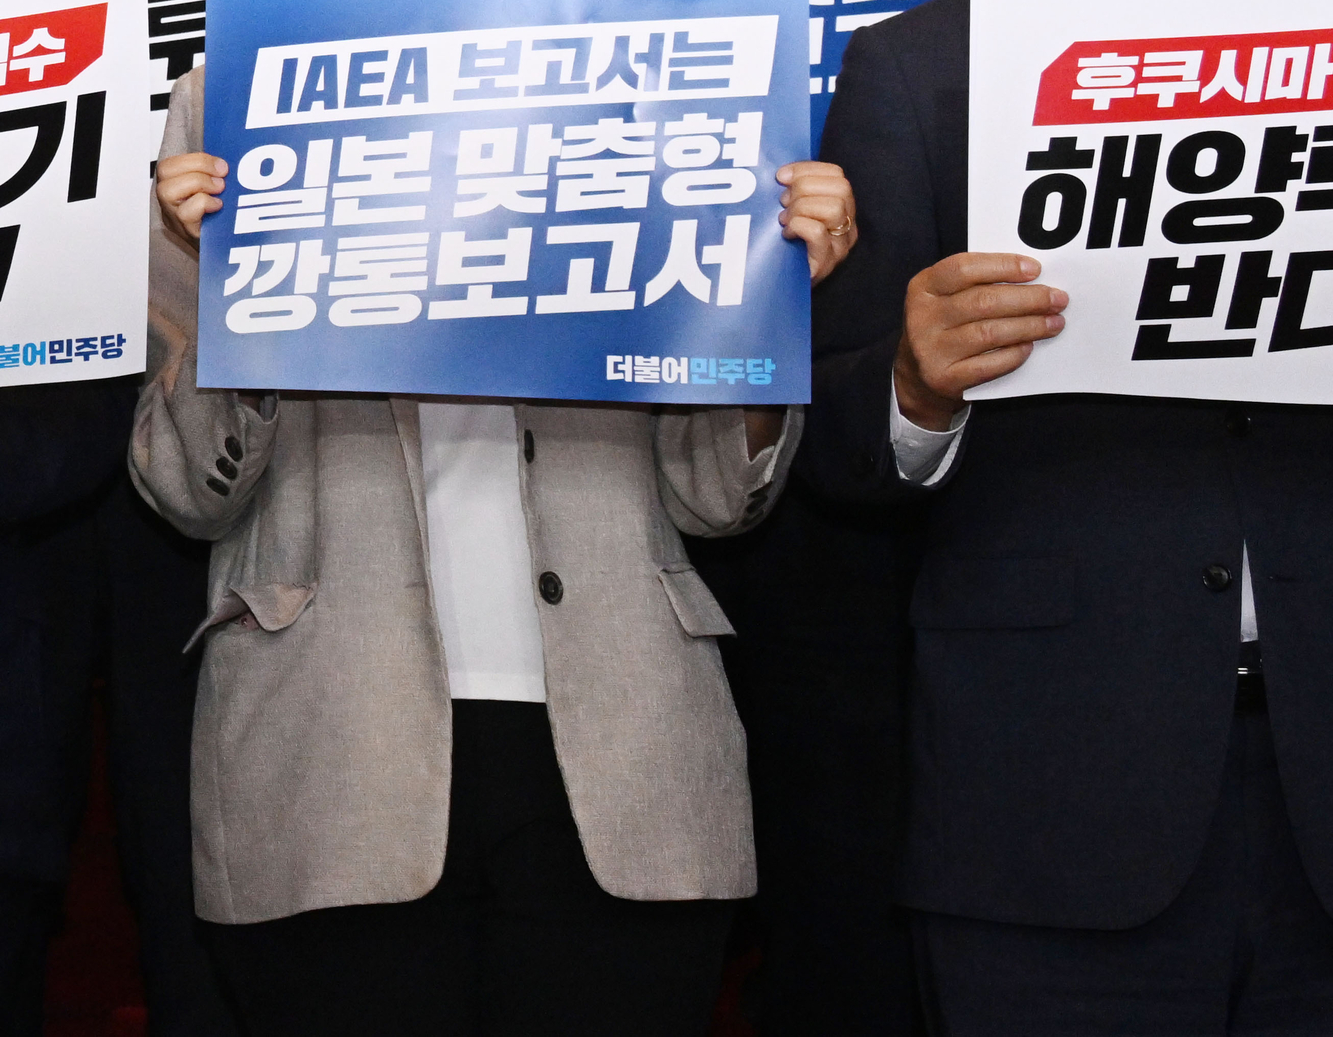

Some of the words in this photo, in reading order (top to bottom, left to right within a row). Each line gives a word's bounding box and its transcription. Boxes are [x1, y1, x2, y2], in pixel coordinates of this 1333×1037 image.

[276, 47, 430, 115] IAEA
[452, 29, 733, 102] 보고서는
[1071, 43, 1333, 111] 후쿠시마
[233, 130, 434, 235] 일본
[452, 111, 764, 218] 맞춤형
[1017, 124, 1333, 251] 해양
[223, 213, 752, 334] 깡통보고서
[605, 353, 777, 387] 더불어민주당
